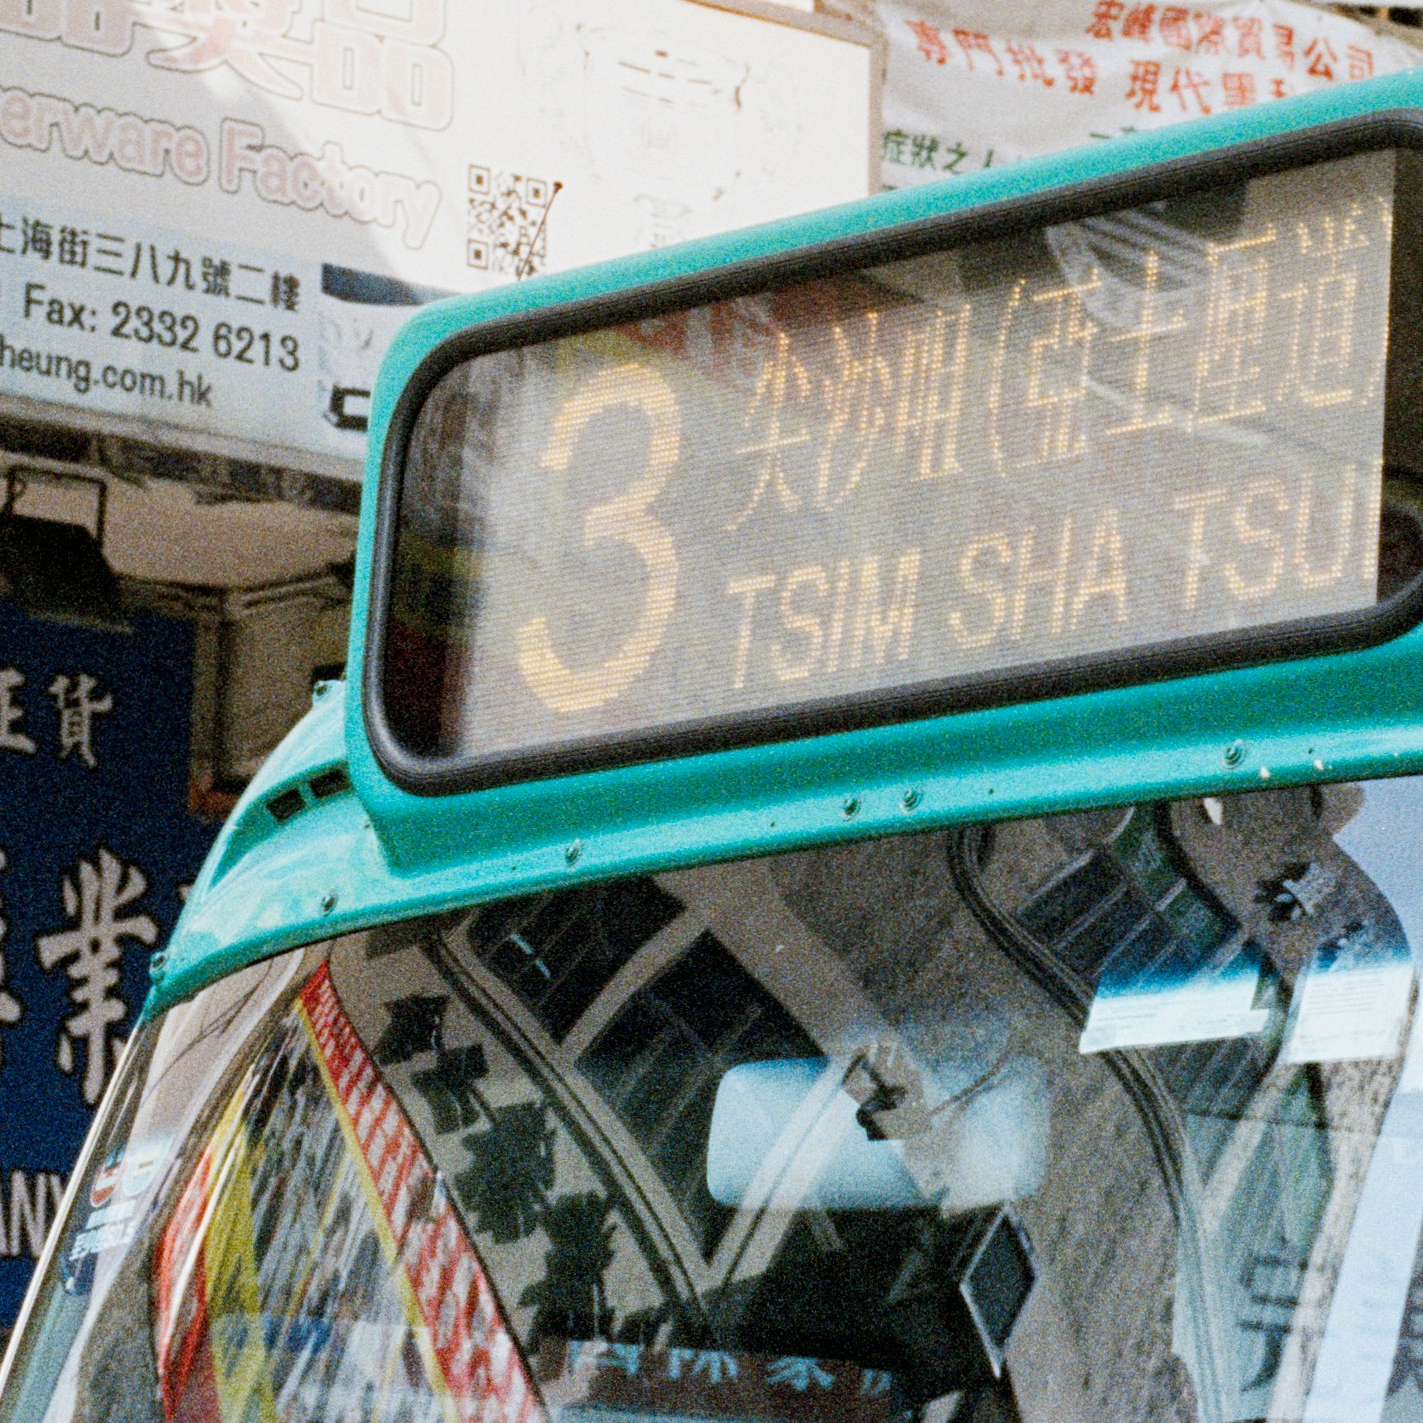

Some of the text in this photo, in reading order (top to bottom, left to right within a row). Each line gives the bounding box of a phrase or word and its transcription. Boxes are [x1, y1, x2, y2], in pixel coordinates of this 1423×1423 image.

[219, 115, 441, 251] Factory
[24, 282, 98, 334] Fax:
[111, 299, 200, 354] 2332
[212, 318, 301, 373] 6213
[515, 363, 681, 716] 3
[728, 457, 1384, 690] TSIM SHA TSUI
